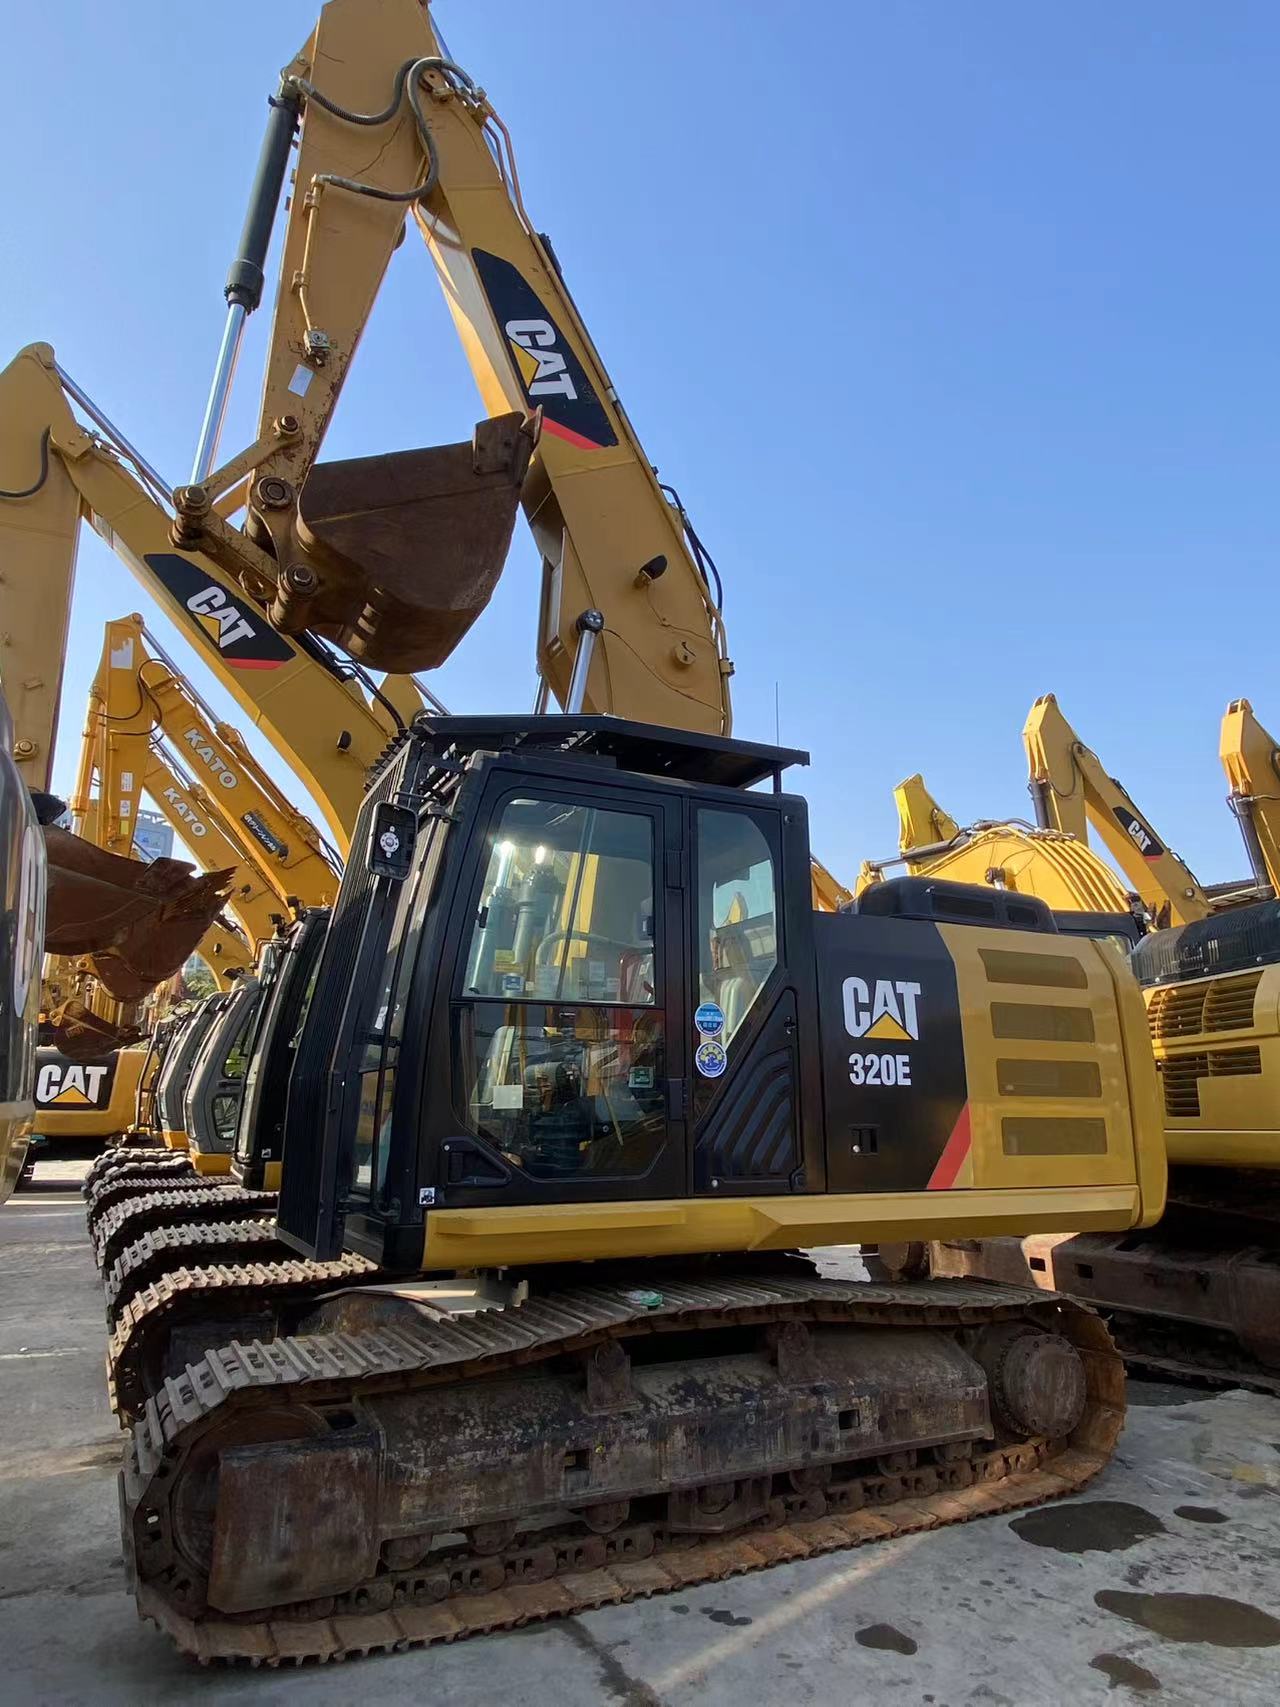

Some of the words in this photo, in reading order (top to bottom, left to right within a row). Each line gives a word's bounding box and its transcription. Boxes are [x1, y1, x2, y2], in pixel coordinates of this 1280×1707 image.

[505, 319, 578, 400] CAT
[186, 586, 256, 648] CAT
[183, 728, 239, 789] KATO
[162, 786, 207, 837] KATO
[1128, 820, 1152, 852] CAT
[842, 976, 921, 1041] CAT
[36, 1064, 108, 1104] CAT
[848, 1053, 912, 1086] 320E
